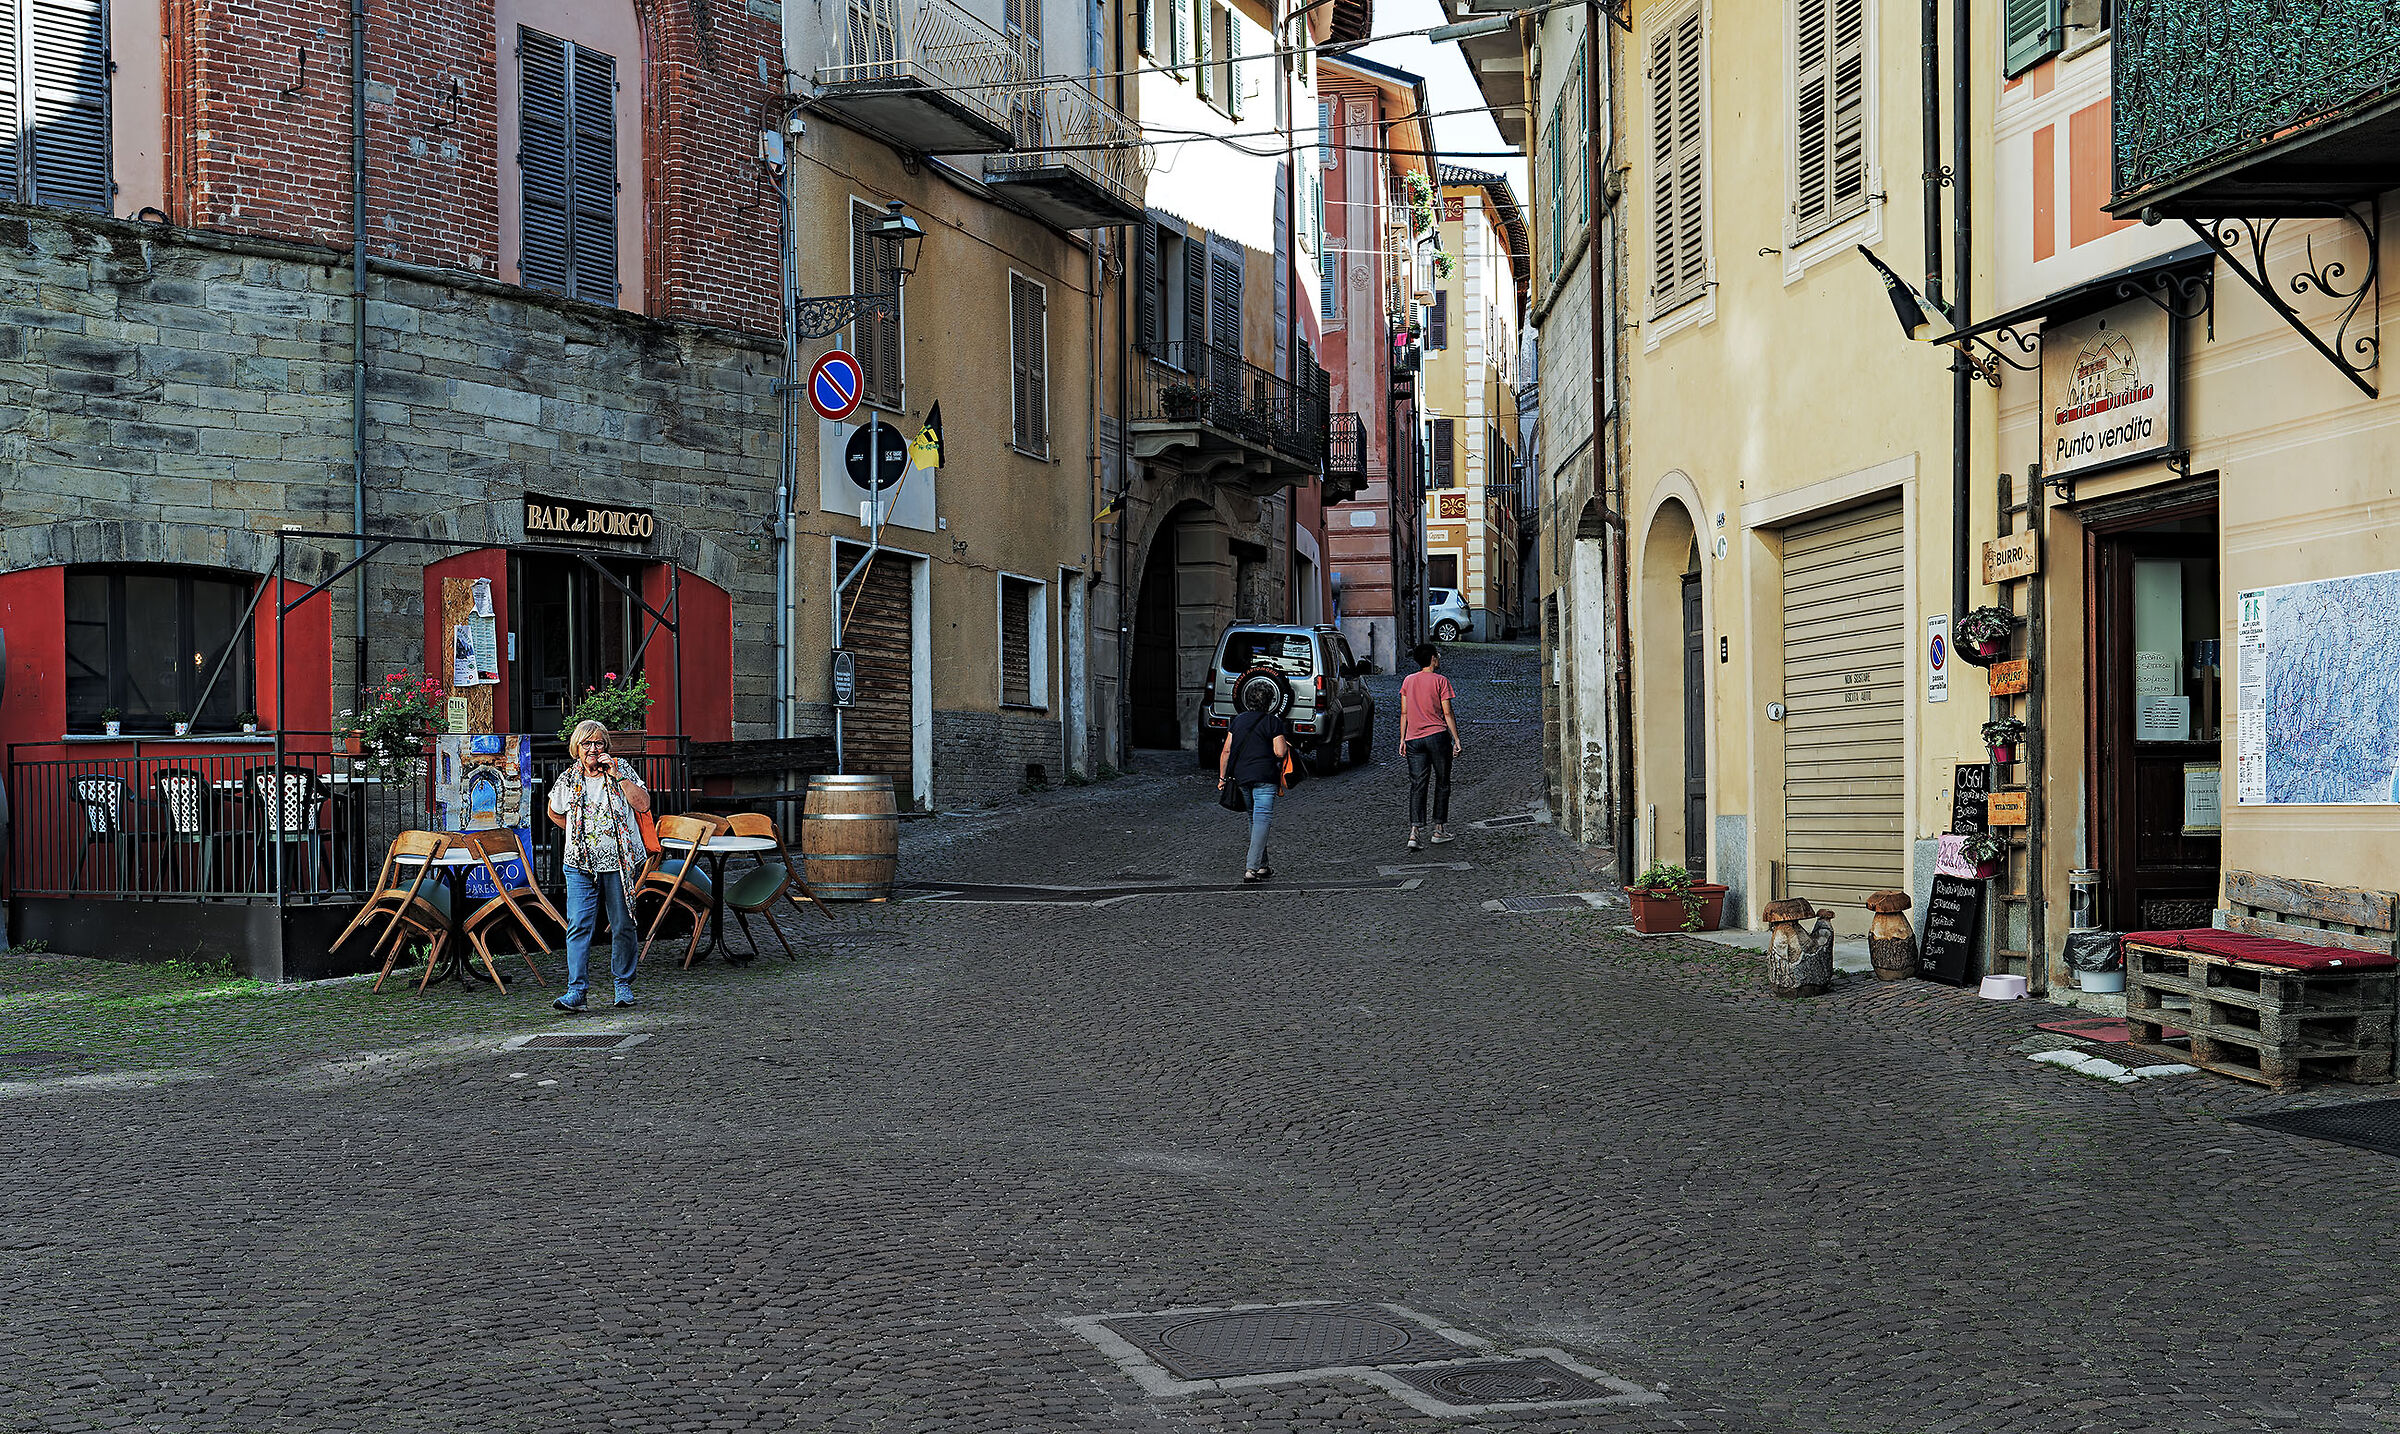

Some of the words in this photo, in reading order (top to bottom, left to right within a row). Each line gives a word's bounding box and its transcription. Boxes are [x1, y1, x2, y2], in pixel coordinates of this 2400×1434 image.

[2056, 431, 2094, 461] Punto
[2098, 414, 2153, 450] vendita
[526, 504, 571, 532] BAR
[570, 517, 587, 533] del
[586, 508, 654, 538] BORGO
[1996, 546, 2023, 567] BURRO
[1929, 682, 1947, 691] carrabile
